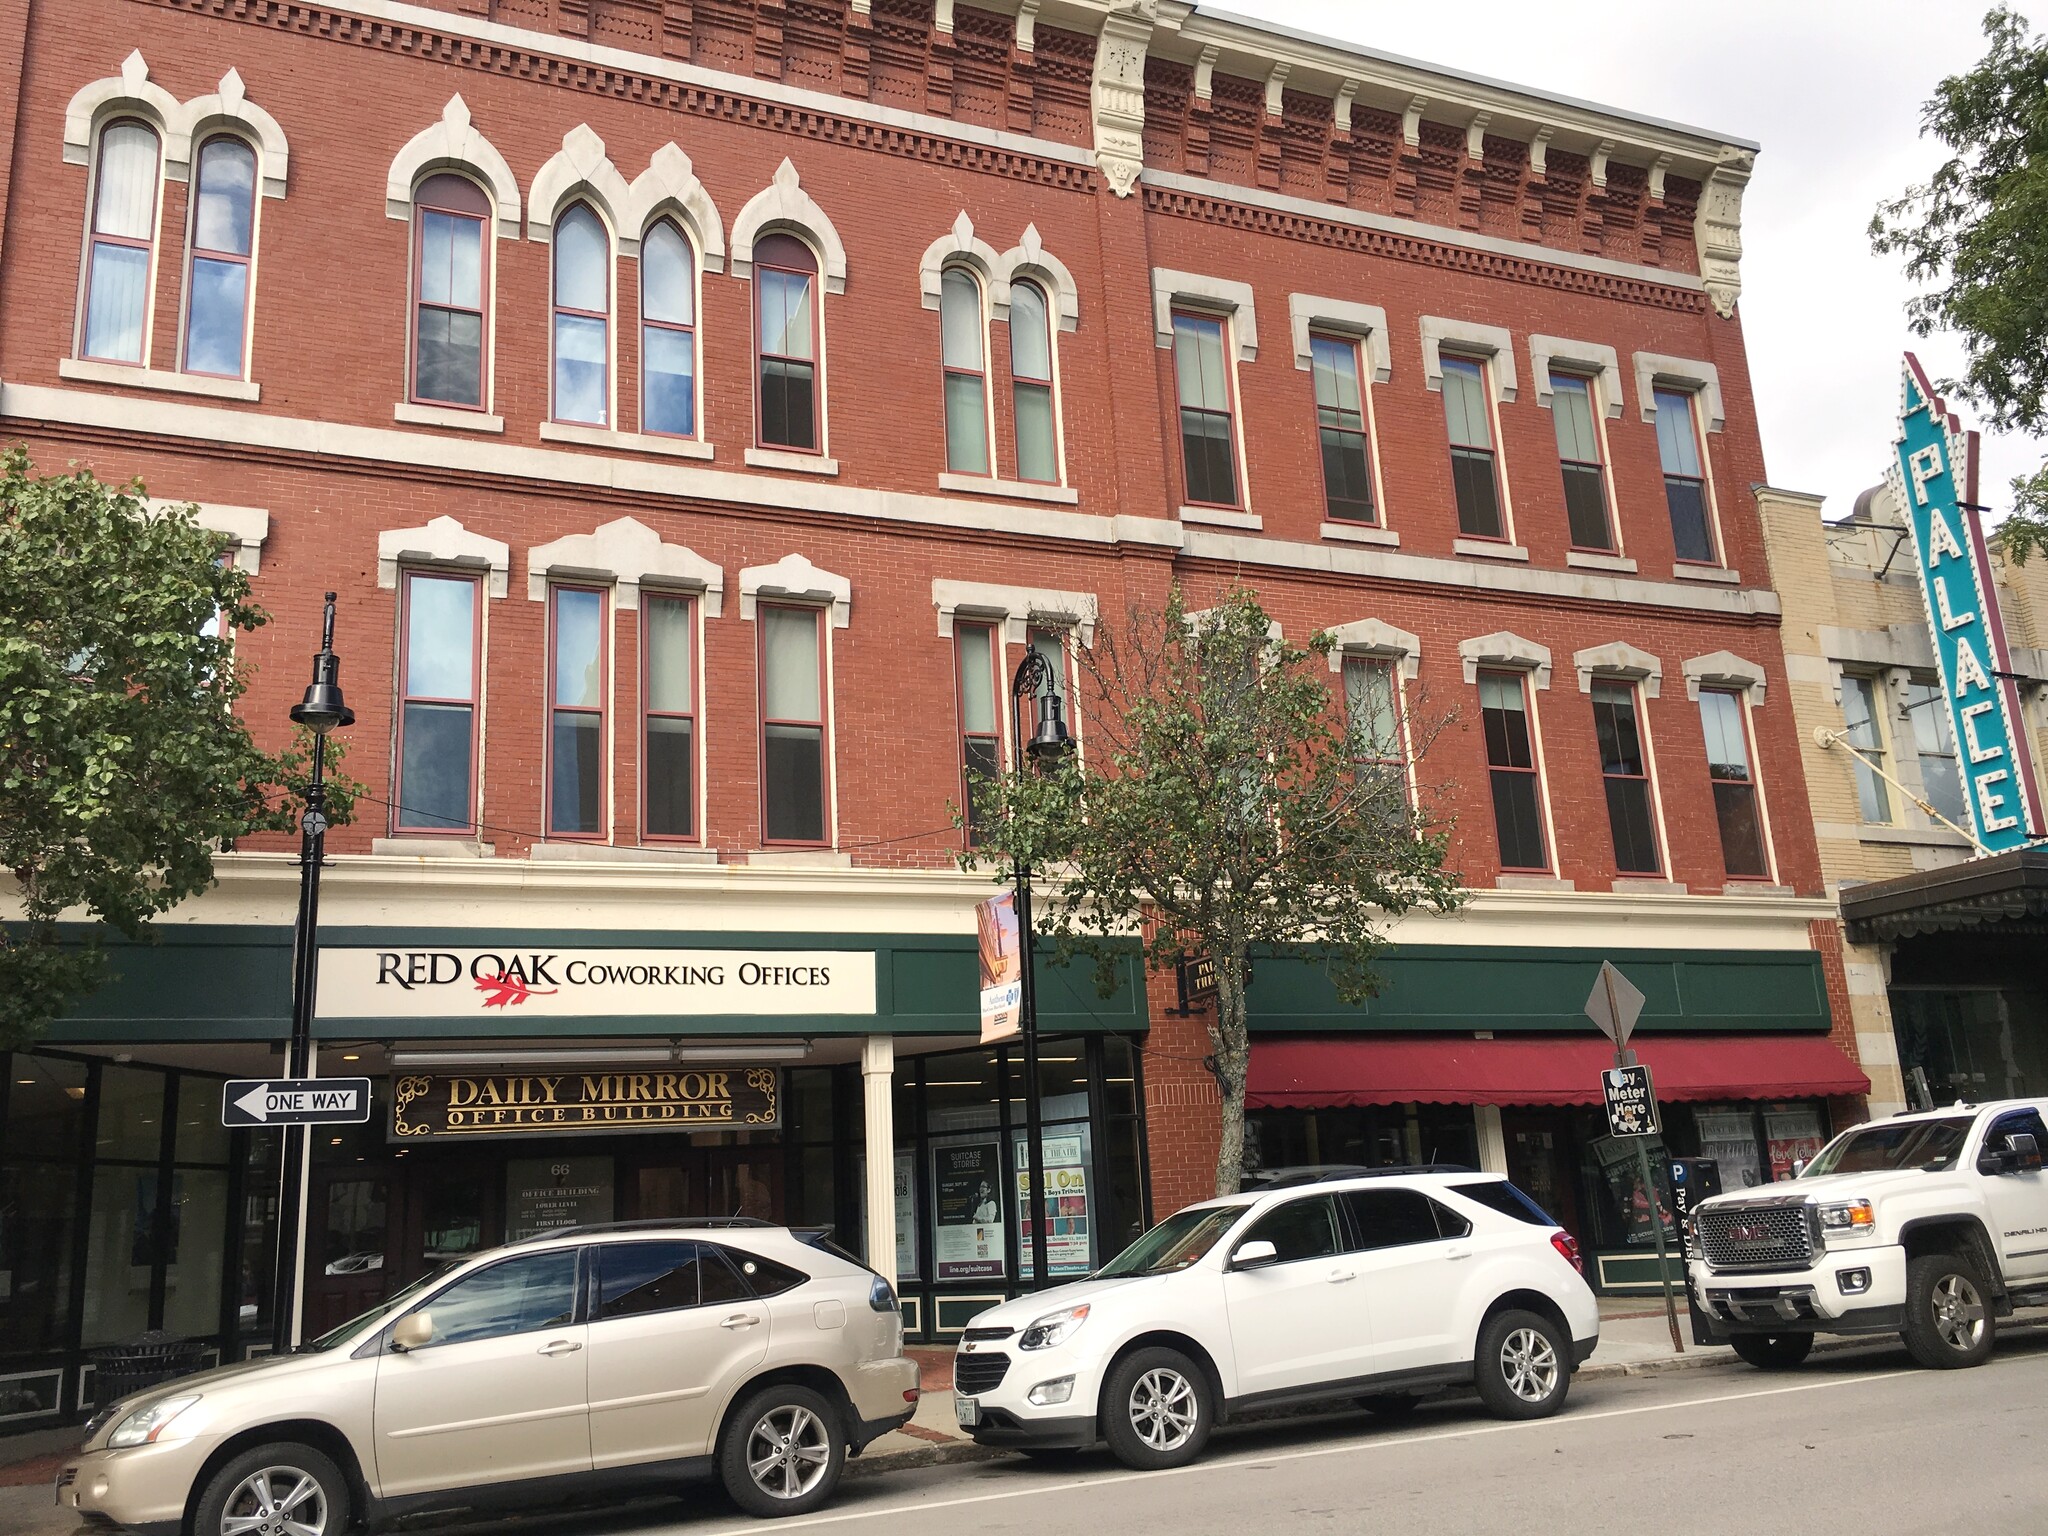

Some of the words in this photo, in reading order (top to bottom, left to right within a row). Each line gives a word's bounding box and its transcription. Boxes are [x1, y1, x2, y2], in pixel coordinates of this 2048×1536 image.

[1908, 441, 2018, 833] PALACE
[376, 953, 463, 990] RED
[470, 954, 561, 985] OAK
[447, 1076, 565, 1106] DAILY
[579, 1073, 732, 1102] MIRROR
[1607, 1086, 1646, 1101] Meter
[265, 1094, 304, 1110] ONE
[312, 1093, 351, 1109] WAY
[1614, 1103, 1646, 1116] Here
[447, 1108, 565, 1125] OFFICE
[581, 1104, 734, 1120] BUILDING
[951, 1151, 982, 1161] SUITCASE
[1726, 1143, 1758, 1159] RITTER
[1769, 1145, 1793, 1164] Love
[551, 1164, 570, 1176] 66
[953, 1159, 980, 1169] STORIES
[1672, 1164, 1684, 1181] P
[1057, 1170, 1085, 1188] On
[521, 1190, 555, 1198] OFFICE
[556, 1187, 600, 1197] BUILDING
[895, 1187, 908, 1197] 018
[1675, 1187, 1687, 1214] Pay
[1681, 1218, 1689, 1229] &
[1728, 1224, 1770, 1241] GMC
[2003, 1228, 2035, 1237] DENALI
